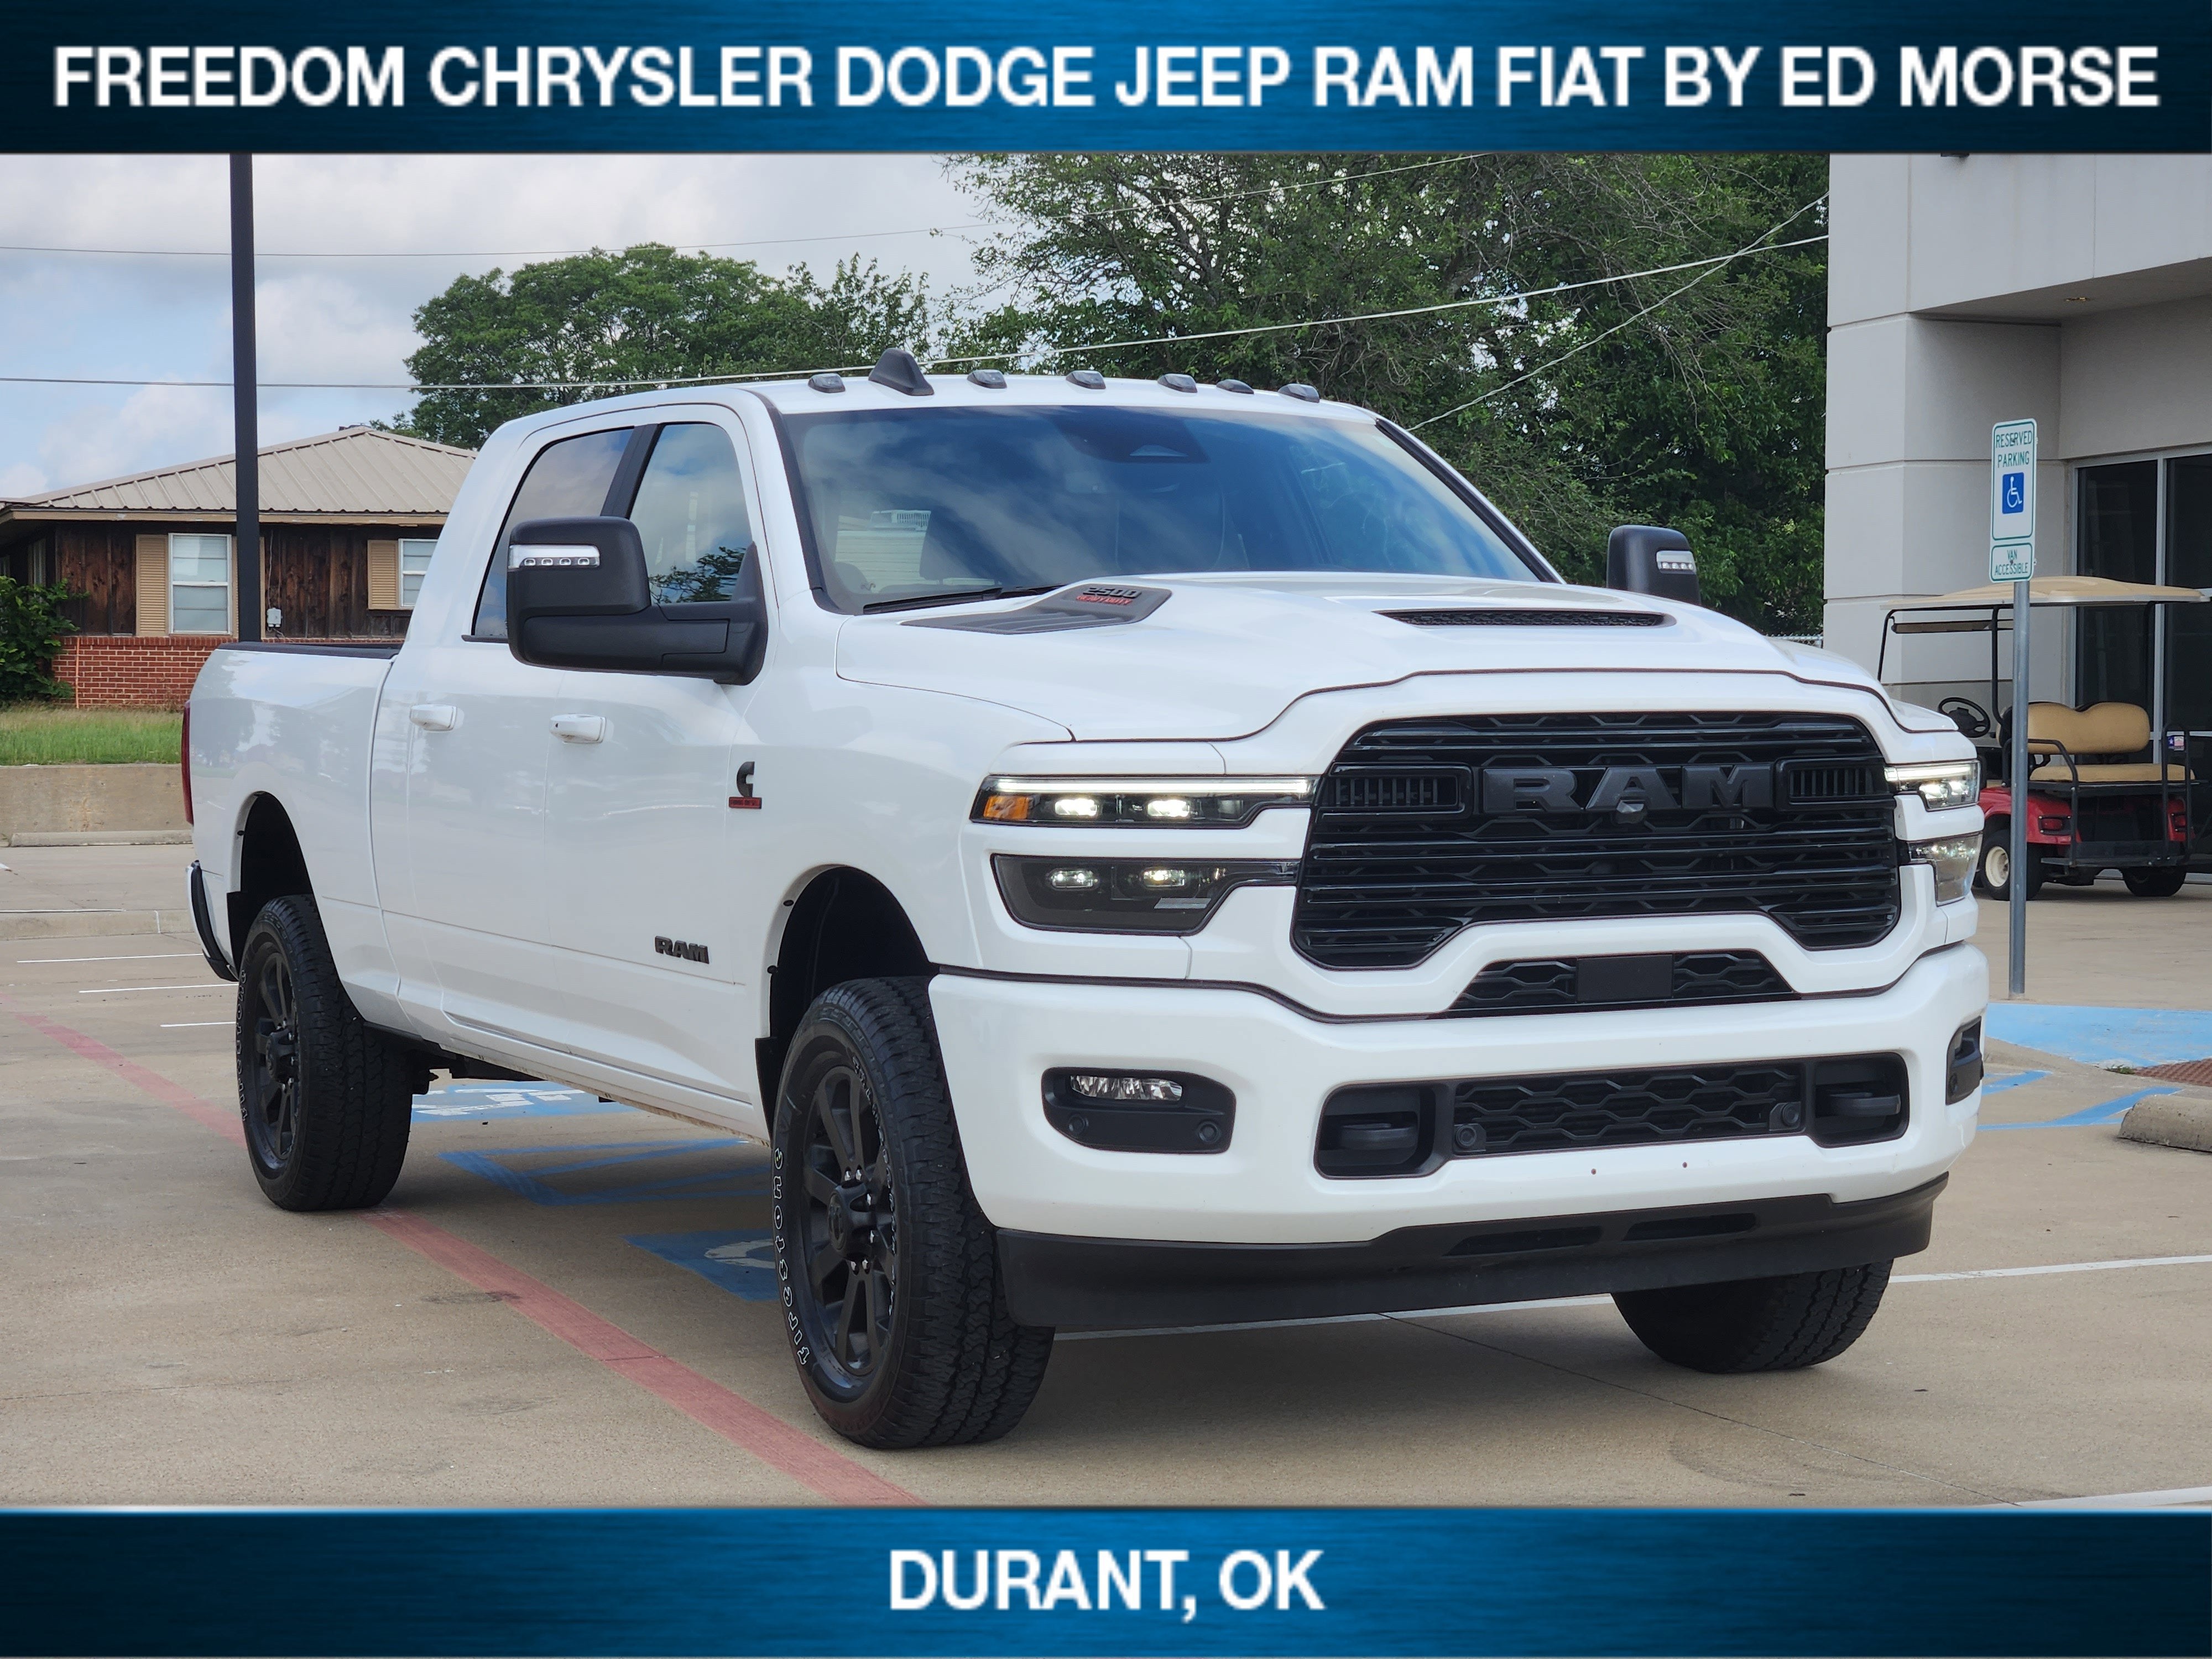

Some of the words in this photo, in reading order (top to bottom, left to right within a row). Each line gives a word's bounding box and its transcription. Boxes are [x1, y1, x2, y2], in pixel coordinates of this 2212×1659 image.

[1995, 430, 2032, 448] RESERVED
[1997, 451, 2030, 468] PARKING
[2007, 550, 2018, 560] VAN
[1994, 562, 2028, 576] ACCESSIBLE
[1083, 587, 1142, 599] 2500
[1483, 765, 1771, 814] RAM
[655, 936, 709, 964] RAM
